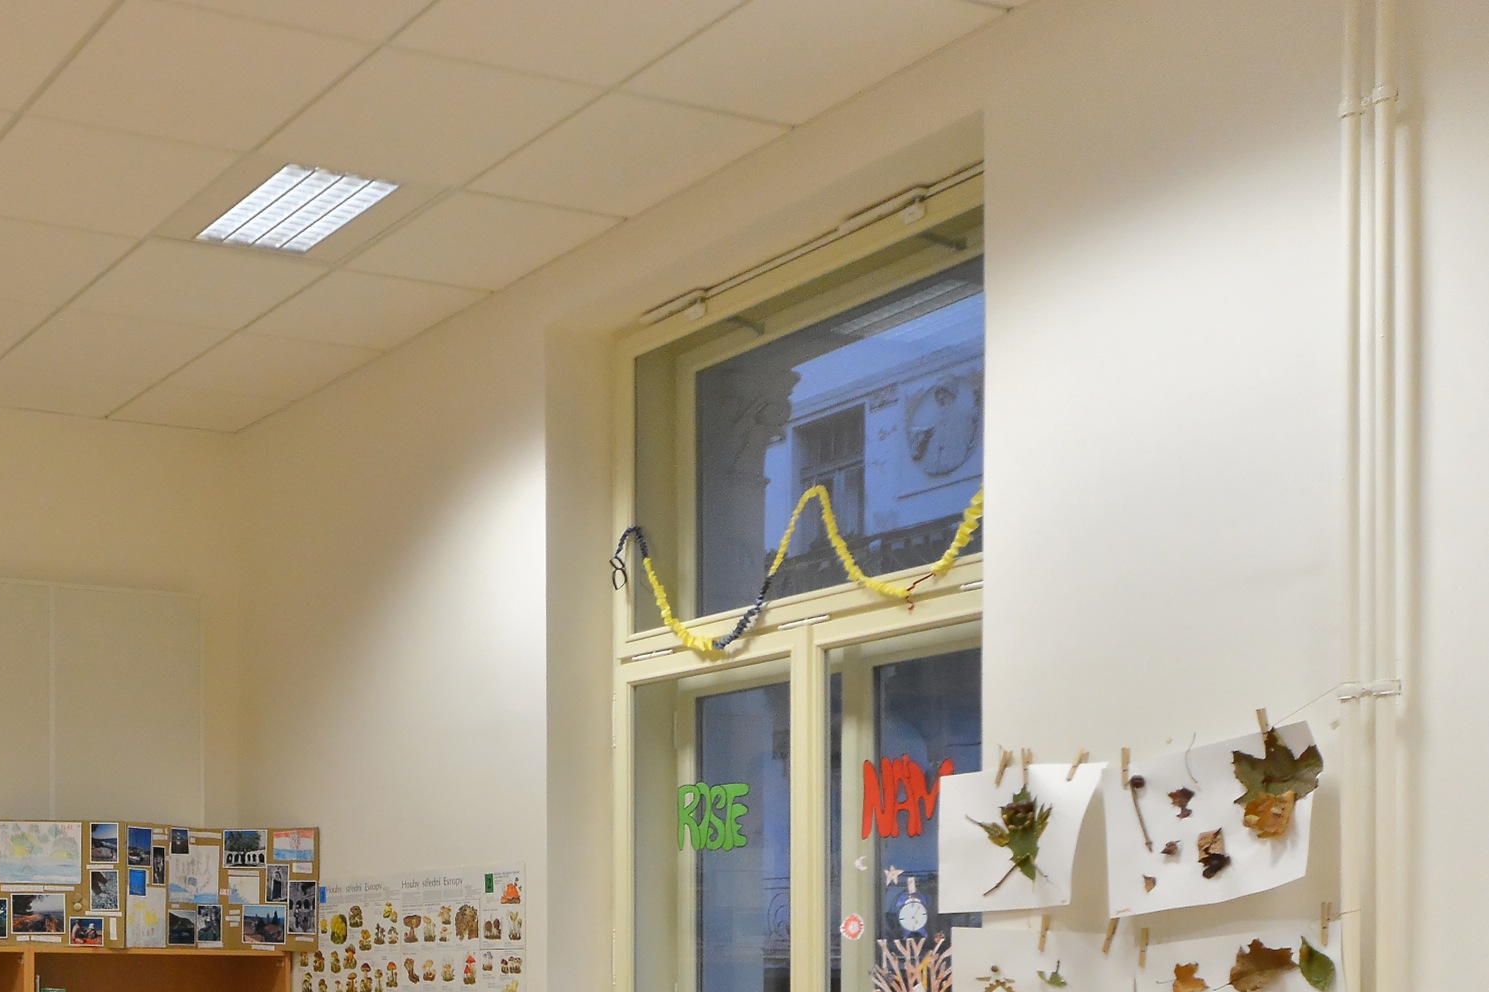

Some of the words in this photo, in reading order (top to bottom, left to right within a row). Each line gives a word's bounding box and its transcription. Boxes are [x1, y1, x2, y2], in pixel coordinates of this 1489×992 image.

[401, 879, 420, 889] Houby
[422, 876, 442, 888] střední
[443, 875, 463, 887] Evropy
